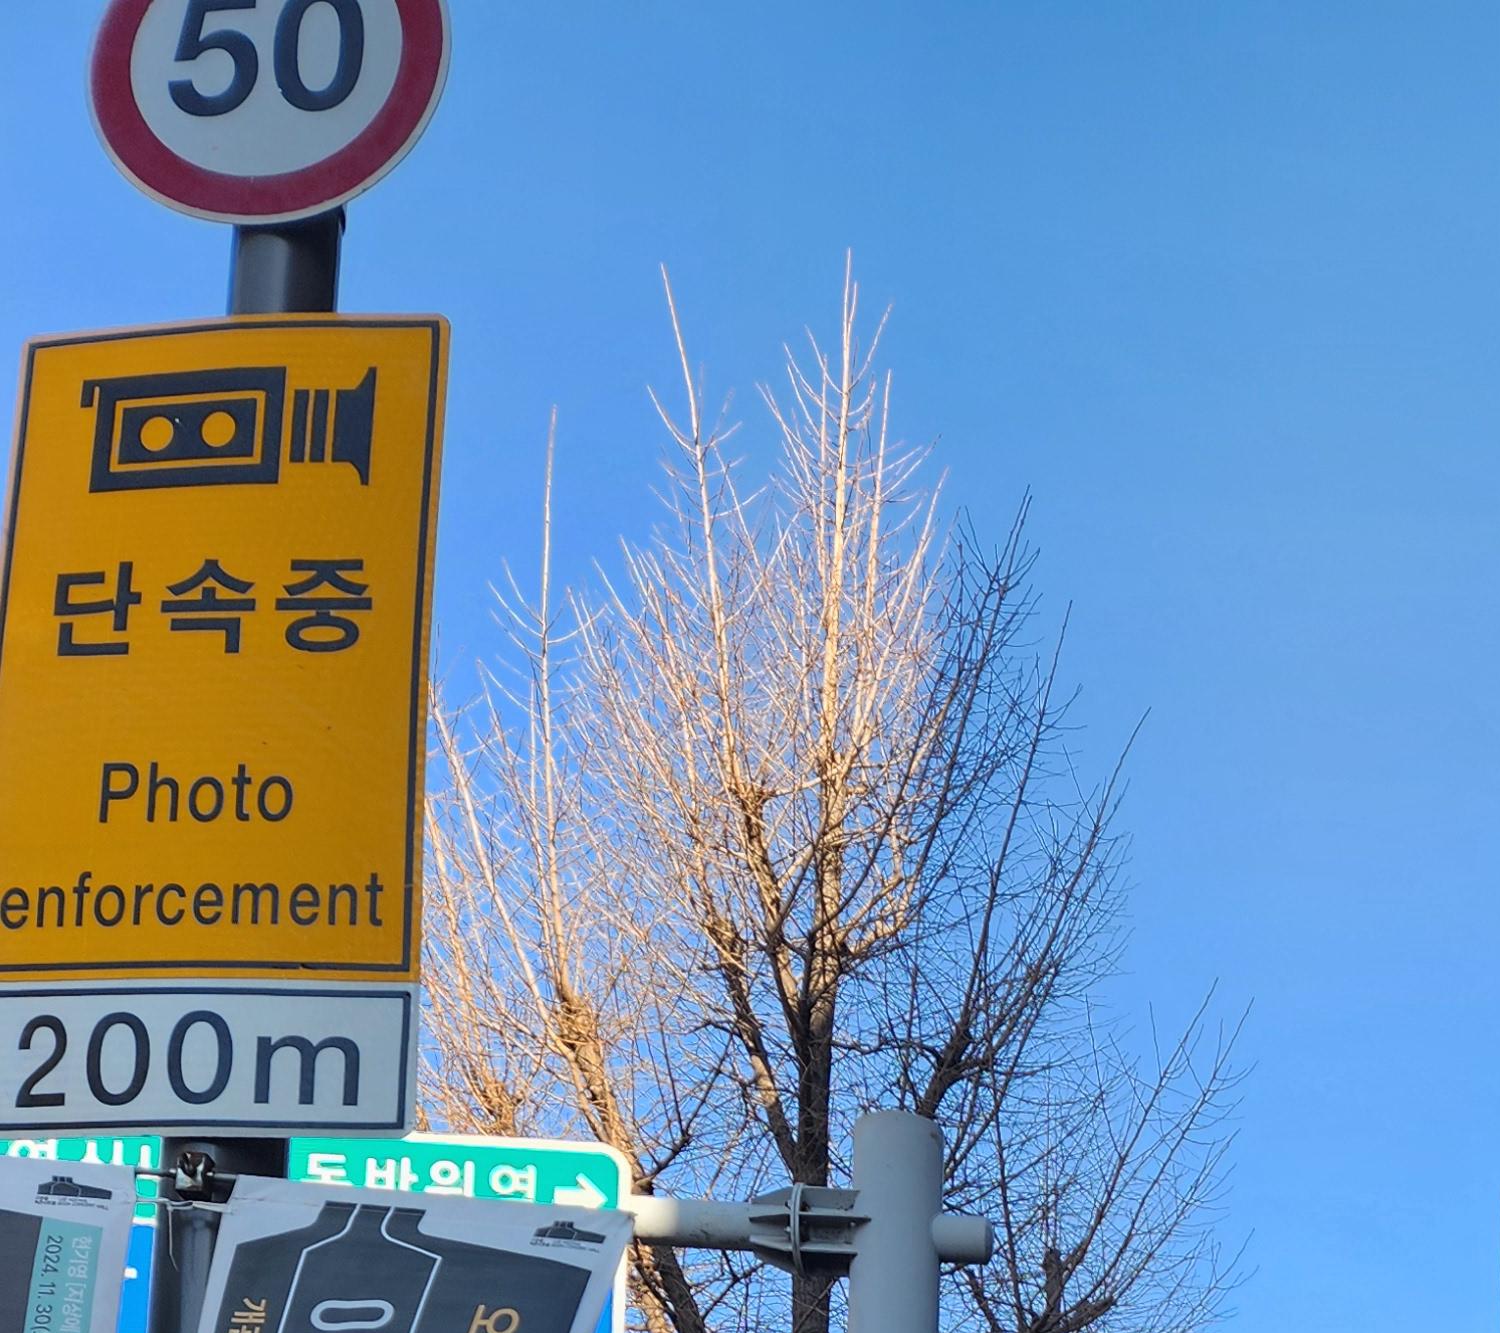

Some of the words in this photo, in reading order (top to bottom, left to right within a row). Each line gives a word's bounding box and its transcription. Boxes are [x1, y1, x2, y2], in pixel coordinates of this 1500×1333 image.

[167, 0, 365, 118] 50
[53, 558, 374, 657] 단속중
[98, 762, 295, 826] Photo
[0, 871, 385, 929] enforcement
[16, 1010, 363, 1110] 200m
[40, 1234, 62, 1276] 2024.
[69, 1236, 93, 1278] 현기영
[37, 1282, 56, 1298] 11.
